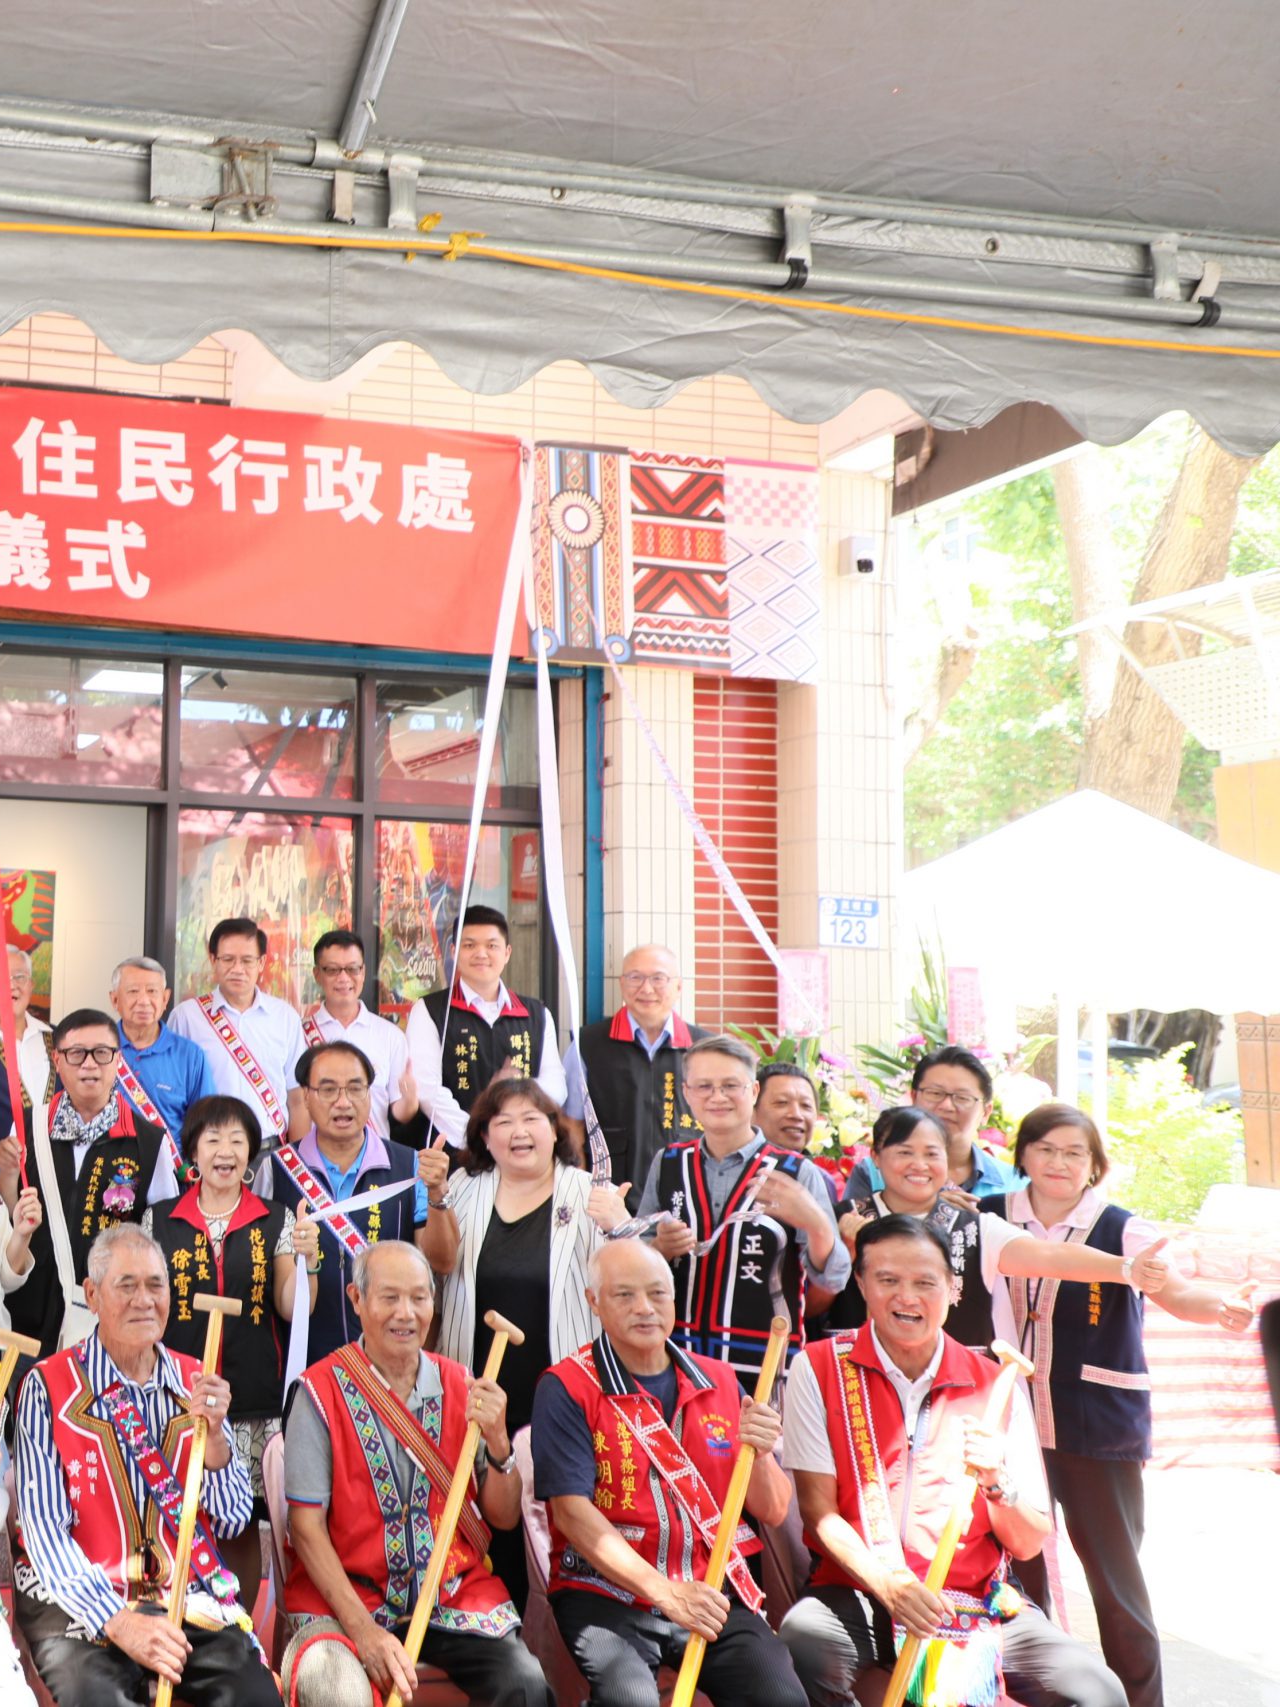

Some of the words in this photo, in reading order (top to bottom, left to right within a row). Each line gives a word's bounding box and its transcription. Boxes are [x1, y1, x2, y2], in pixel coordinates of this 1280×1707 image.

[829, 918, 867, 945] 123
[171, 1248, 193, 1321] 徐雪玉
[194, 1231, 211, 1282] 副議長
[249, 1228, 267, 1326] 花蓮縣議會
[613, 1411, 638, 1510] 落事務組長
